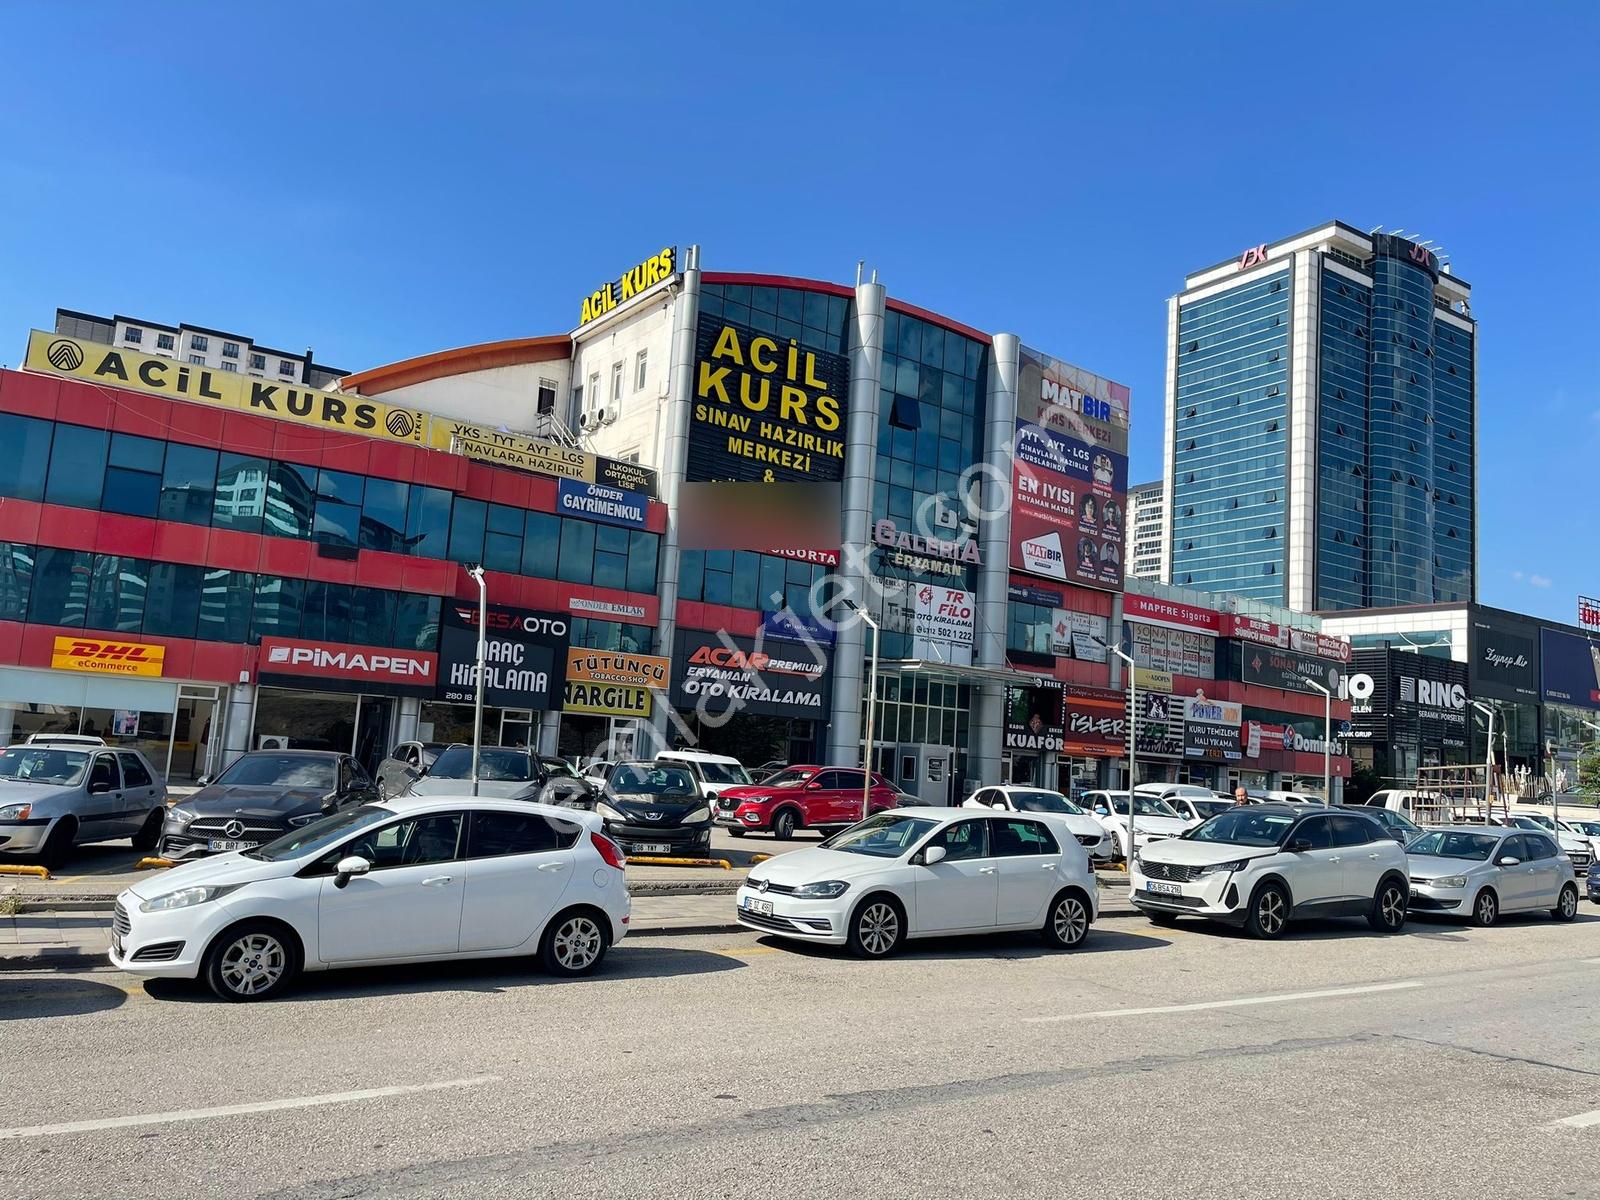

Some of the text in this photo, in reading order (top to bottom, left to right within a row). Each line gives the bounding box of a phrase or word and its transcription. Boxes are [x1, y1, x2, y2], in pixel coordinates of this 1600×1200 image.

[621, 247, 673, 302] KURS
[250, 382, 377, 430] KURS
[698, 361, 840, 432] KURS
[695, 404, 844, 458] SINAV HAZIRLIK
[453, 423, 480, 439] YKS
[492, 432, 516, 449] TYT
[527, 442, 550, 456] AYT
[561, 451, 585, 465] LGS
[1020, 428, 1039, 443] TYT
[1047, 438, 1065, 453] AYT
[1073, 447, 1090, 461] LGS
[1020, 443, 1057, 461] SINAVLARA
[728, 436, 812, 472] MERKEZİ
[1020, 451, 1067, 474] KURSLARINDA
[528, 455, 583, 479] HAZIRLIK
[763, 469, 775, 482] &
[604, 469, 649, 486] ORTAOKUL
[1018, 475, 1039, 495] EN
[587, 484, 623, 501] ÖNDER
[1018, 493, 1050, 510] ERYAMAN
[563, 493, 643, 522] GAYRİMENKUL
[895, 553, 962, 576] ERYAMAN
[946, 590, 965, 604] TR
[611, 605, 643, 616] EMLAK
[917, 613, 932, 621] OTO
[1140, 601, 1211, 624] MAPFRE Sigorta
[938, 628, 951, 639] 502
[958, 632, 972, 641] 222
[69, 641, 152, 662] DHL
[688, 646, 823, 673] ACAR PREMIUM
[78, 660, 138, 672] eCommerce
[573, 654, 665, 681] TÜTÜNCÜ
[590, 672, 648, 684] TOBACCO SHOP
[445, 692, 462, 700] 280
[685, 680, 724, 697] OTO
[1189, 725, 1206, 735] KURU
[1006, 733, 1064, 751] KUAFÖR
[1194, 737, 1233, 748] HALI YIKAMA
[1293, 734, 1342, 756] Domio's
[212, 841, 222, 850] 06
